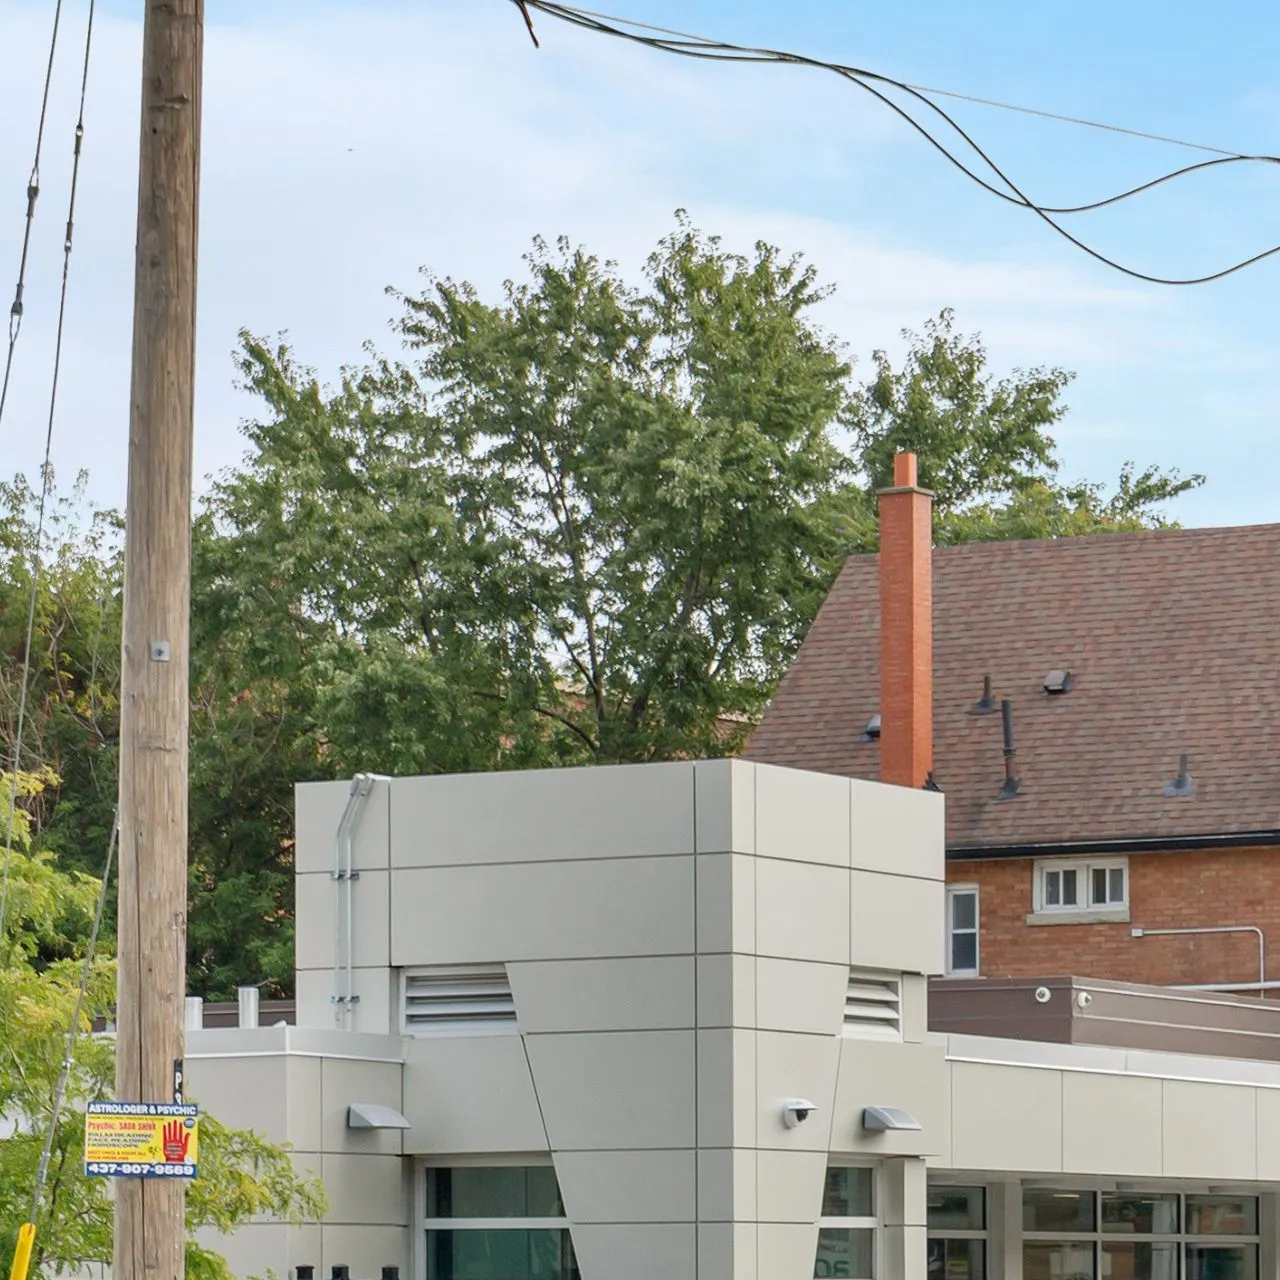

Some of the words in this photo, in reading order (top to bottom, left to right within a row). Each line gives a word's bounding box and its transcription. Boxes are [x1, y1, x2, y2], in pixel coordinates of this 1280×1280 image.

[89, 1103, 148, 1114] ASTROLOGER
[149, 1105, 156, 1114] &
[157, 1105, 196, 1116] PSYCHIC
